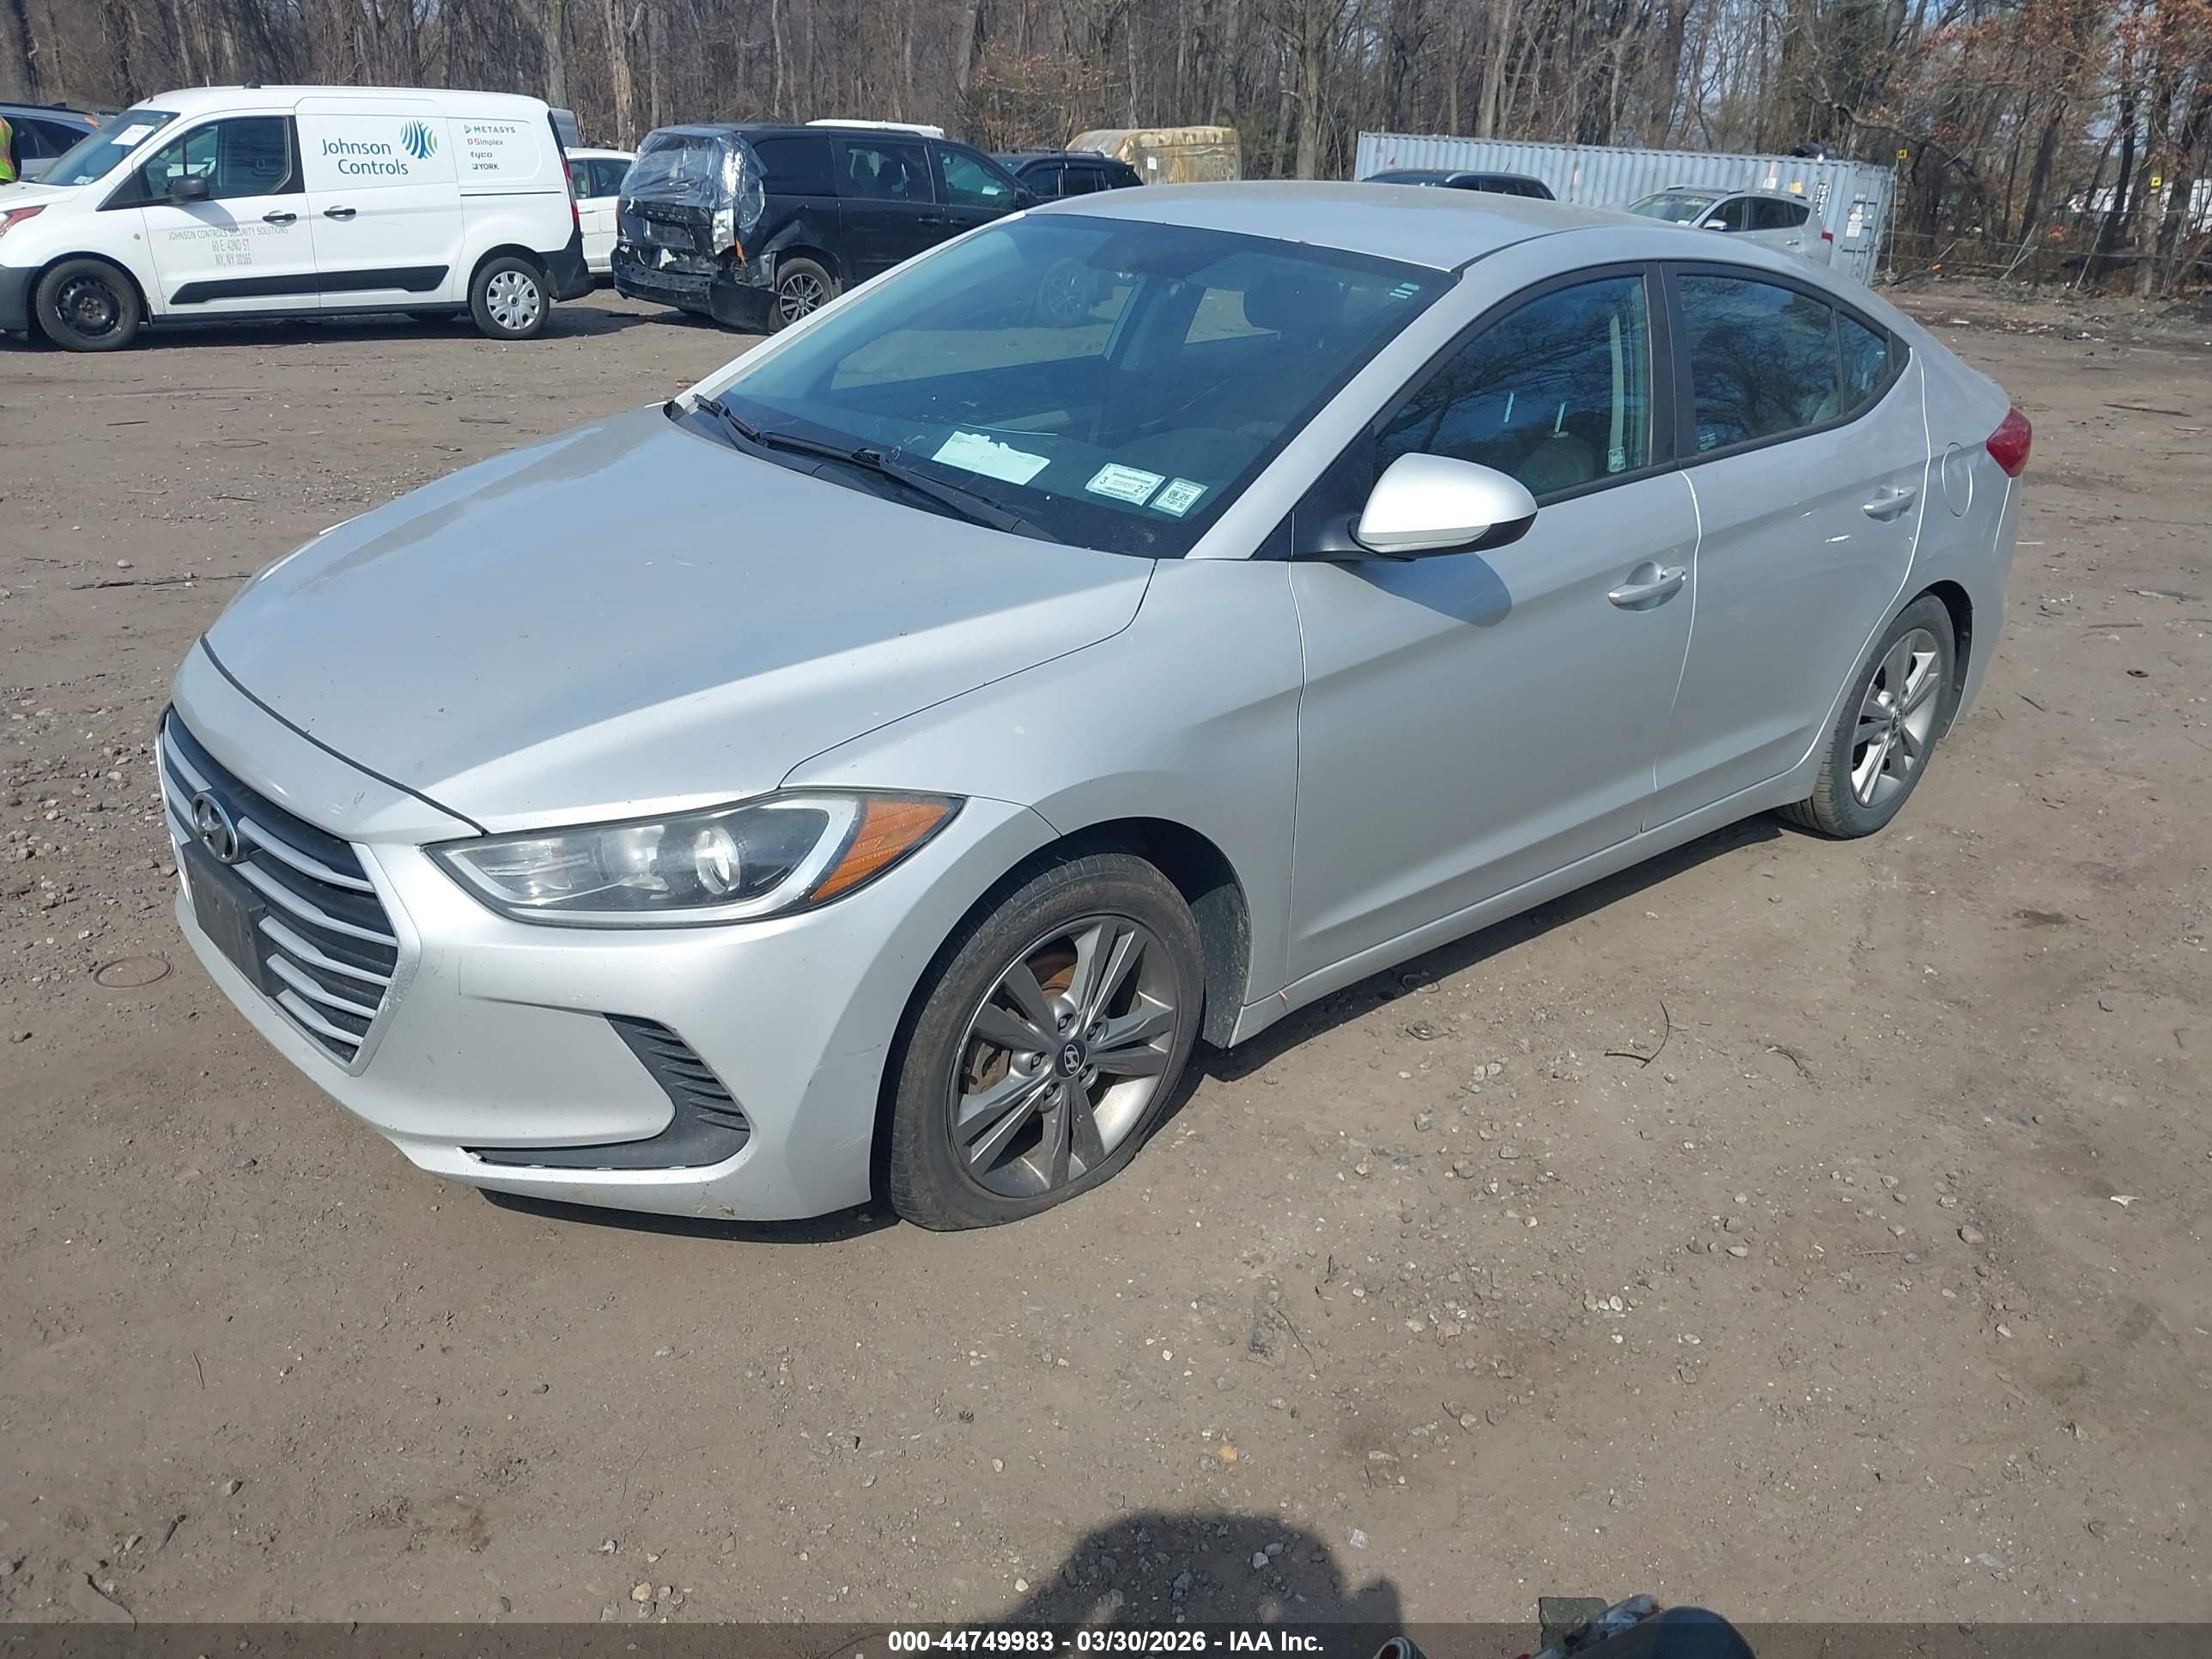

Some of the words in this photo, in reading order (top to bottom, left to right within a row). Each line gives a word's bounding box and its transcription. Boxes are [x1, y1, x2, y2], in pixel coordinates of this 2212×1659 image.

[473, 125, 516, 134] METASYS
[322, 137, 392, 156] Johnson
[470, 151, 493, 160] tyco
[337, 158, 409, 175] Controls
[168, 230, 197, 240] JOHNSON
[198, 228, 228, 239] CONTROLS
[257, 226, 289, 235] SOLUTIONS
[242, 239, 250, 251] ST
[226, 253, 234, 266] NY
[1099, 476, 1108, 484] 3
[1133, 484, 1149, 495] 27
